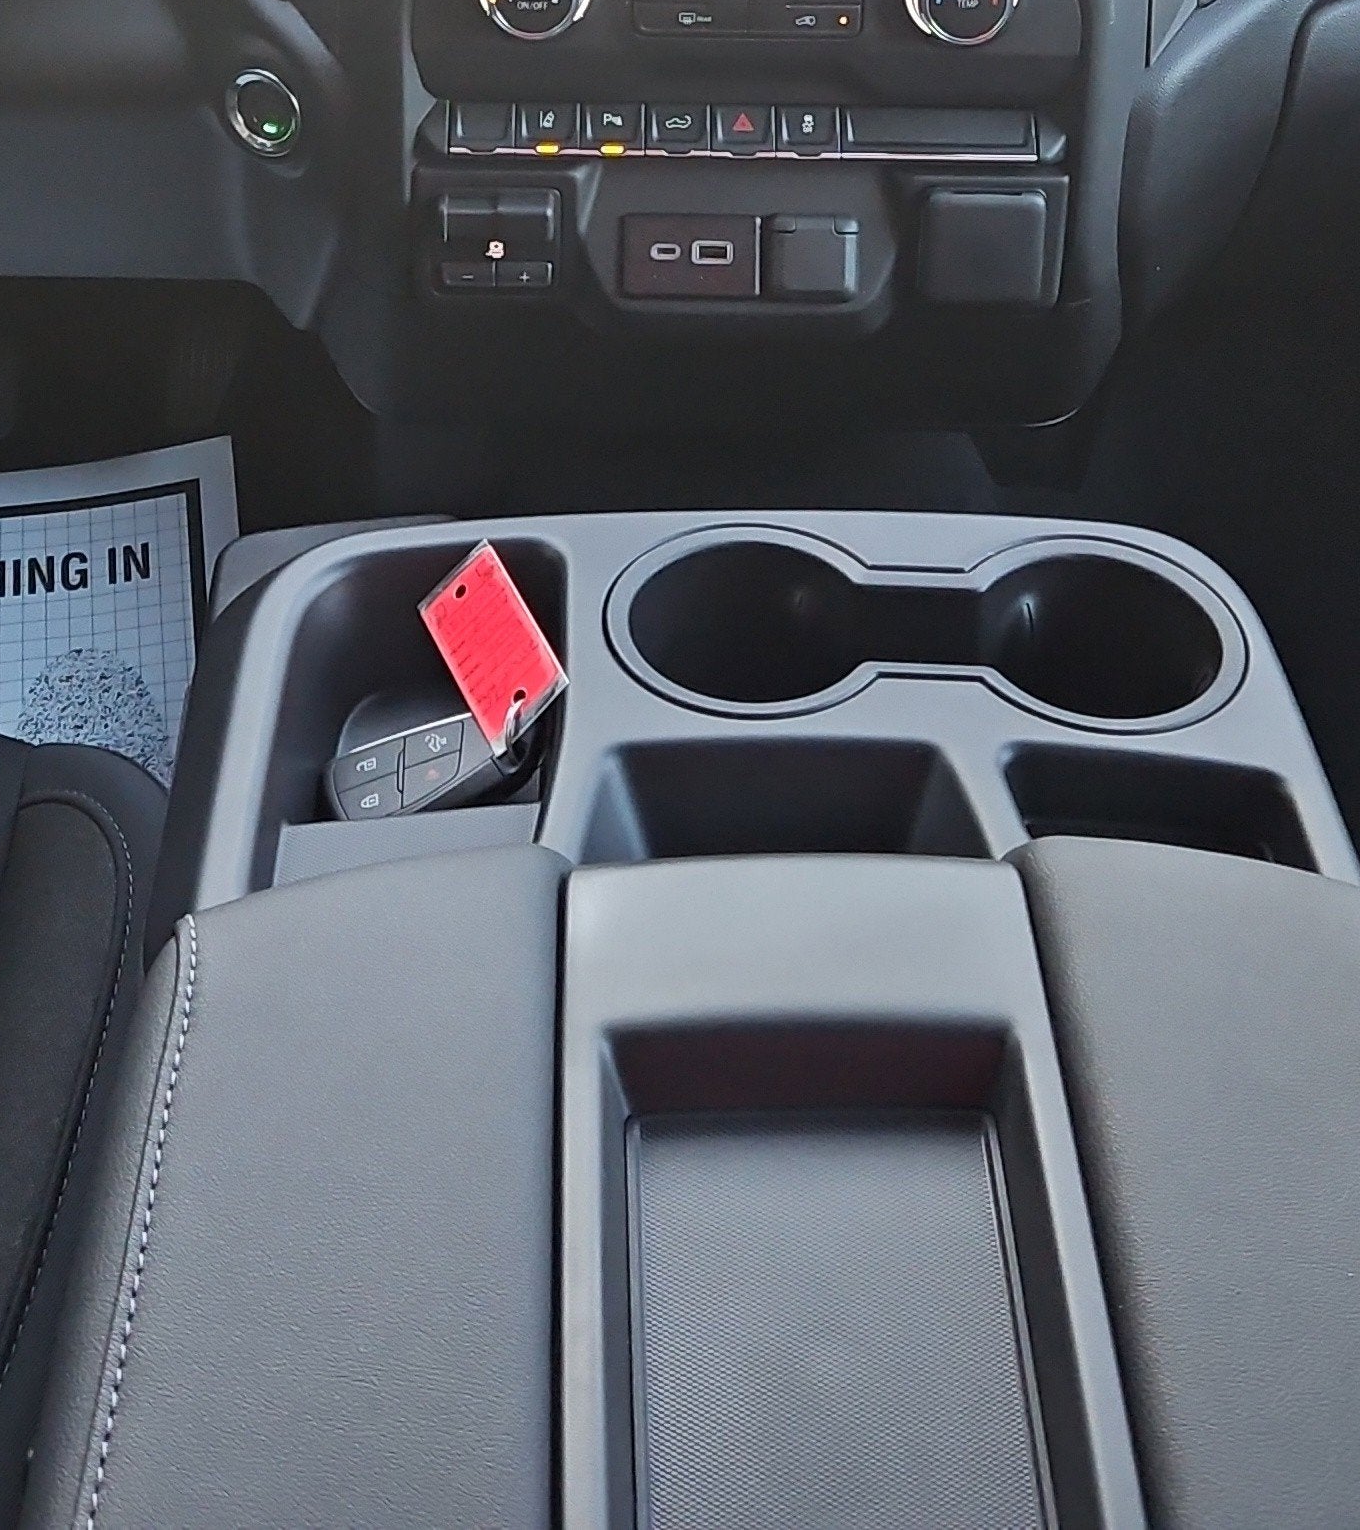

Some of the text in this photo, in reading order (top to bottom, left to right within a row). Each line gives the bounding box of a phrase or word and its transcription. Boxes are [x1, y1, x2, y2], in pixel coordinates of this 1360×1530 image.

[516, 1, 548, 10] ON/OFF
[957, 0, 979, 8] TEMP
[107, 542, 151, 585] IN
